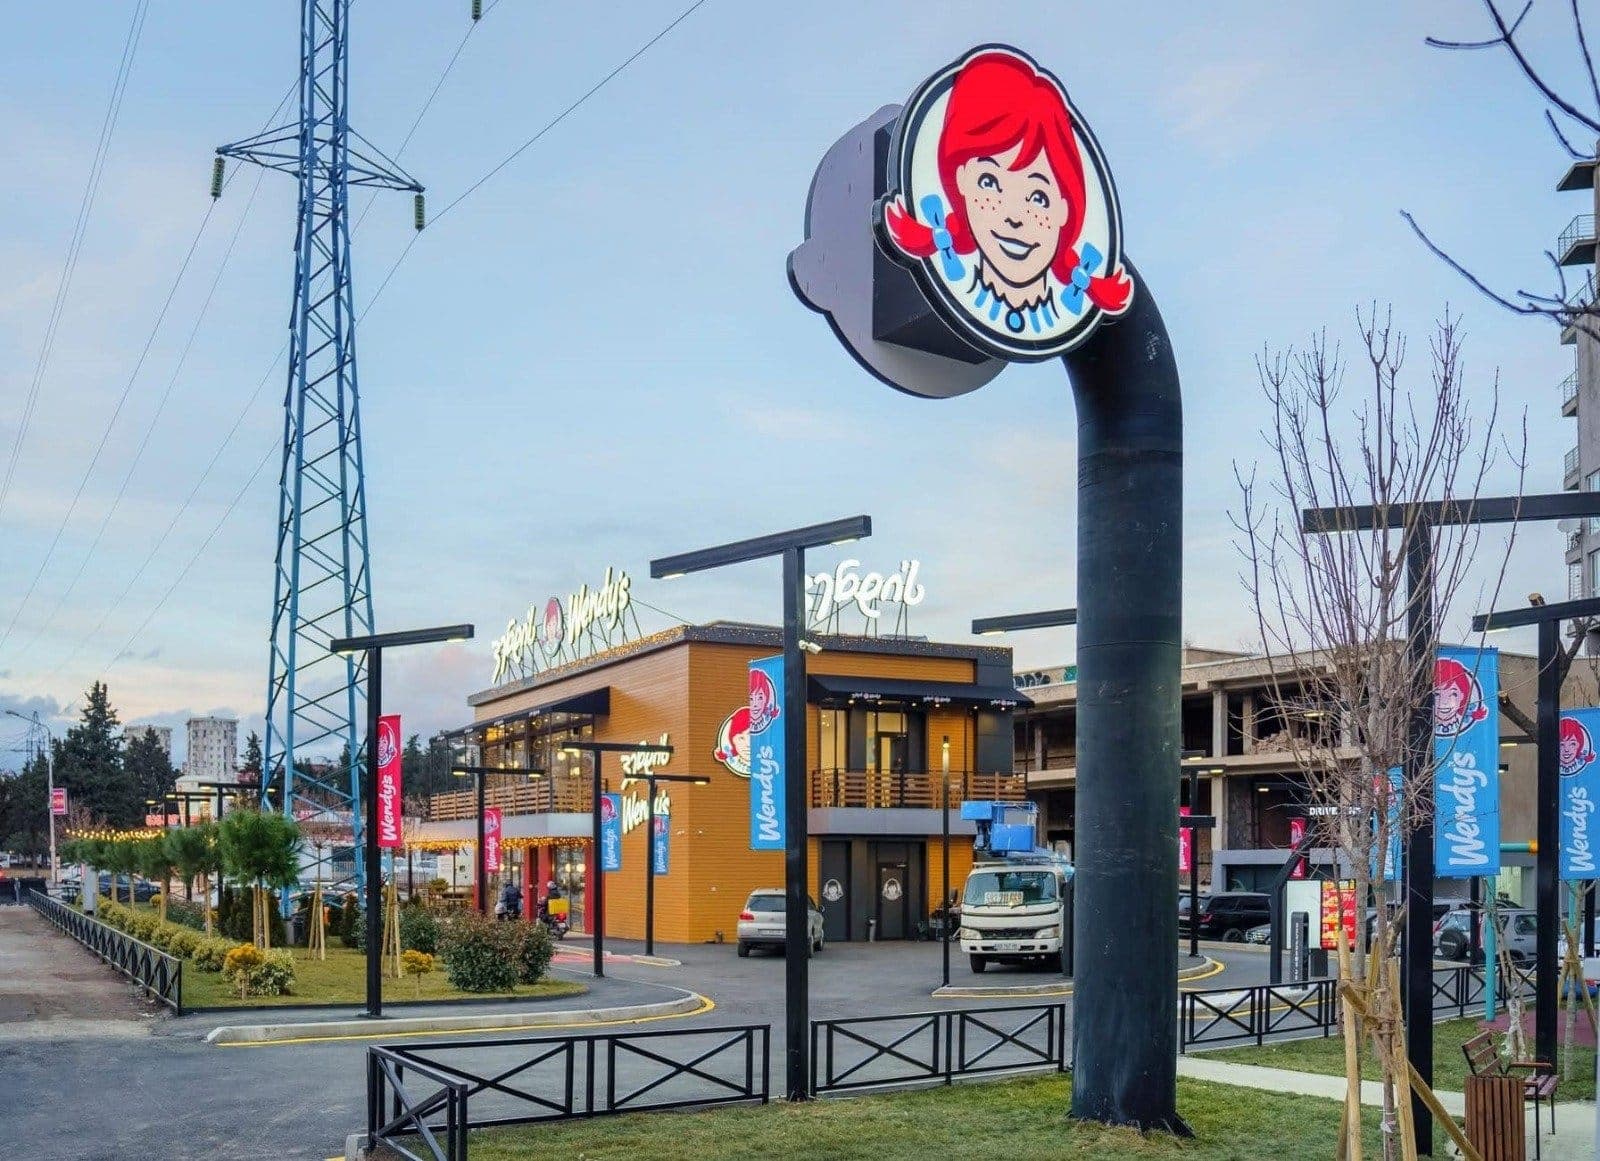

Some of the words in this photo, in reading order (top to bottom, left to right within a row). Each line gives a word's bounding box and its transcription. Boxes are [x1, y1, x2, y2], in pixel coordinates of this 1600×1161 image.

[568, 566, 631, 645] Wendy's
[379, 774, 398, 841] Wendy's
[752, 745, 781, 841] Wendy's
[1309, 806, 1338, 816] DRIVE
[1439, 752, 1488, 865] Wendy's
[1562, 786, 1596, 872] Wendy's
